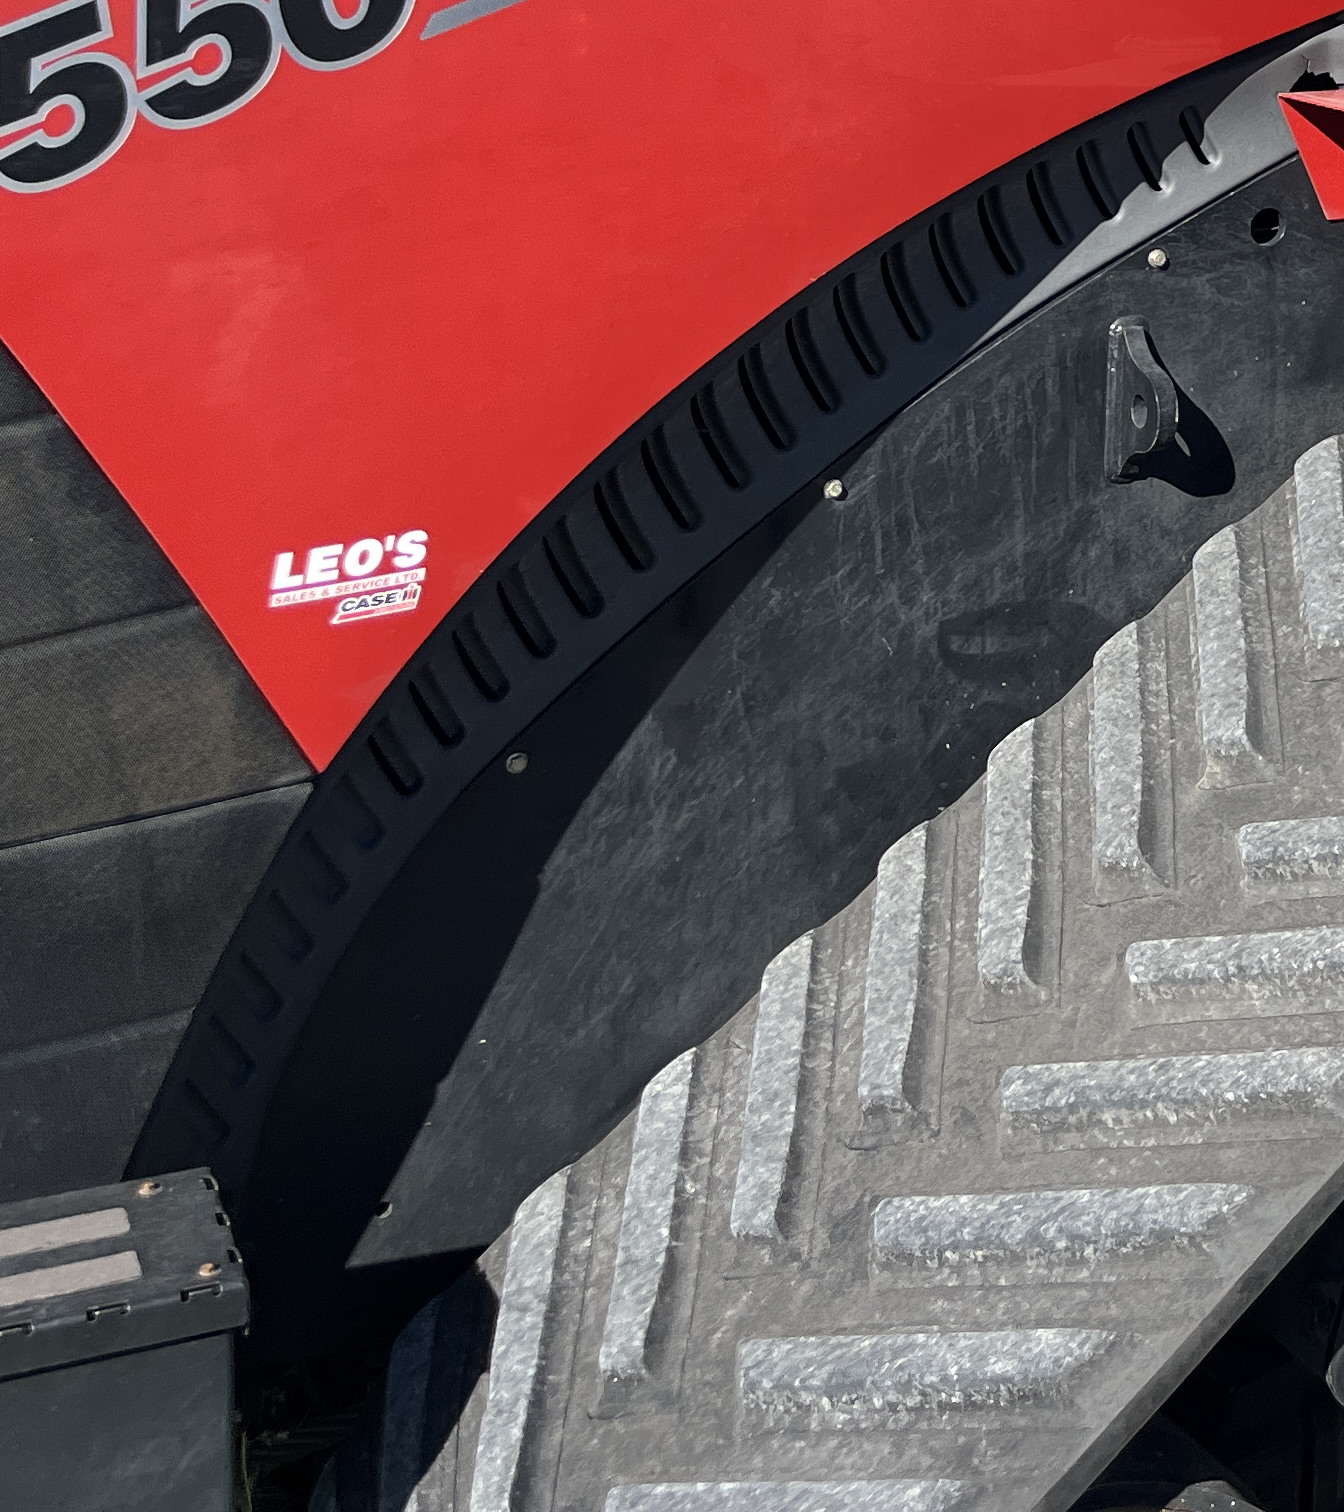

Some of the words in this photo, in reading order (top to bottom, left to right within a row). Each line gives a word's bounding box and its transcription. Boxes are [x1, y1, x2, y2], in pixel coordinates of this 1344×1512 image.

[272, 530, 428, 590] LEO'S
[275, 590, 316, 605] SALES
[320, 587, 330, 597] &
[335, 576, 391, 594] SERVICE
[341, 591, 398, 612] CASE
